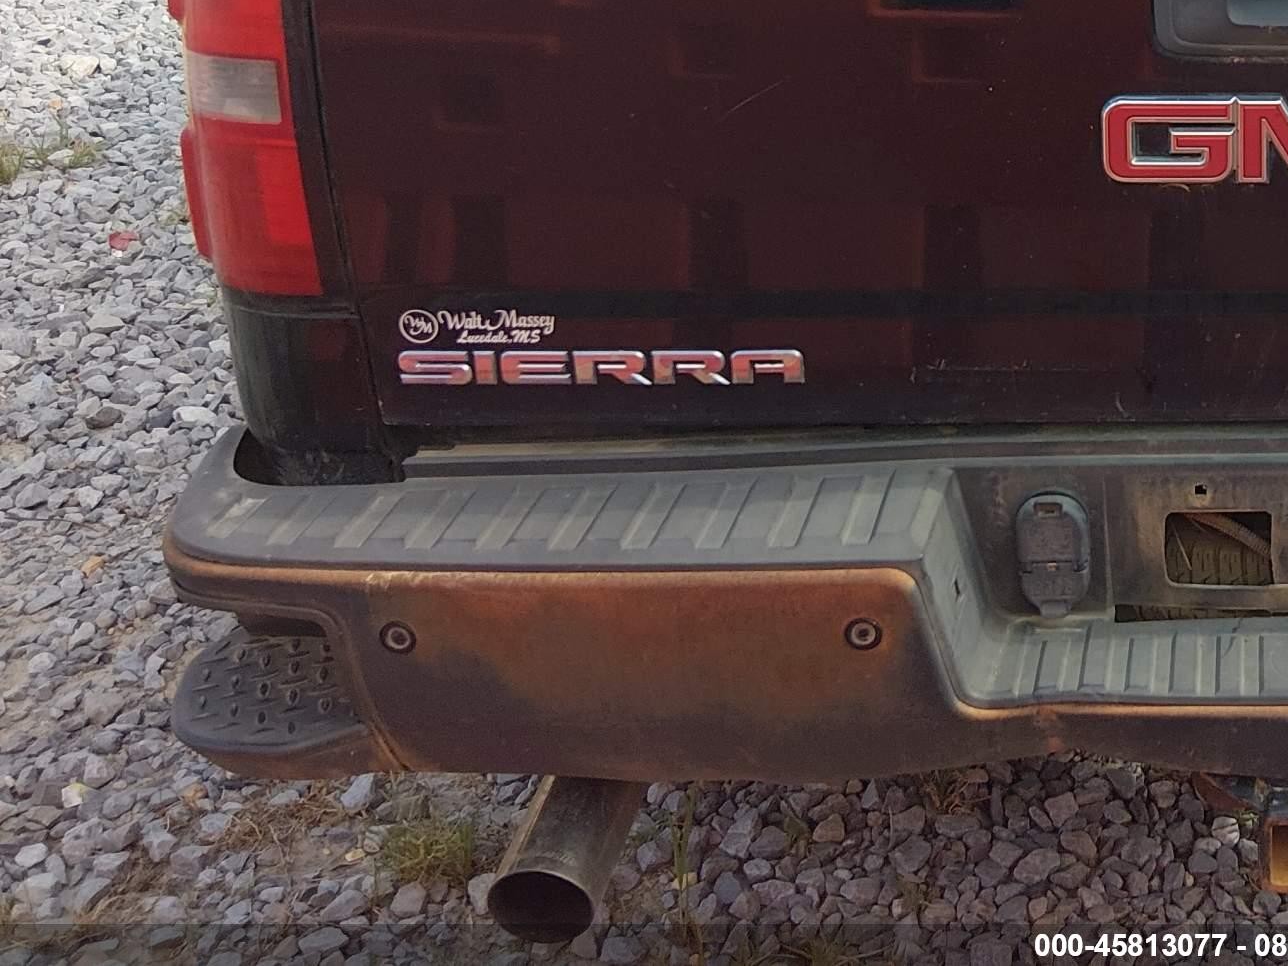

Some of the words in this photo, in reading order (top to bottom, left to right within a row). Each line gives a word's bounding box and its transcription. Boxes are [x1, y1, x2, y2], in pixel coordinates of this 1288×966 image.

[437, 310, 486, 331] Walt
[485, 309, 556, 335] Massey
[398, 349, 805, 386] SIERRA
